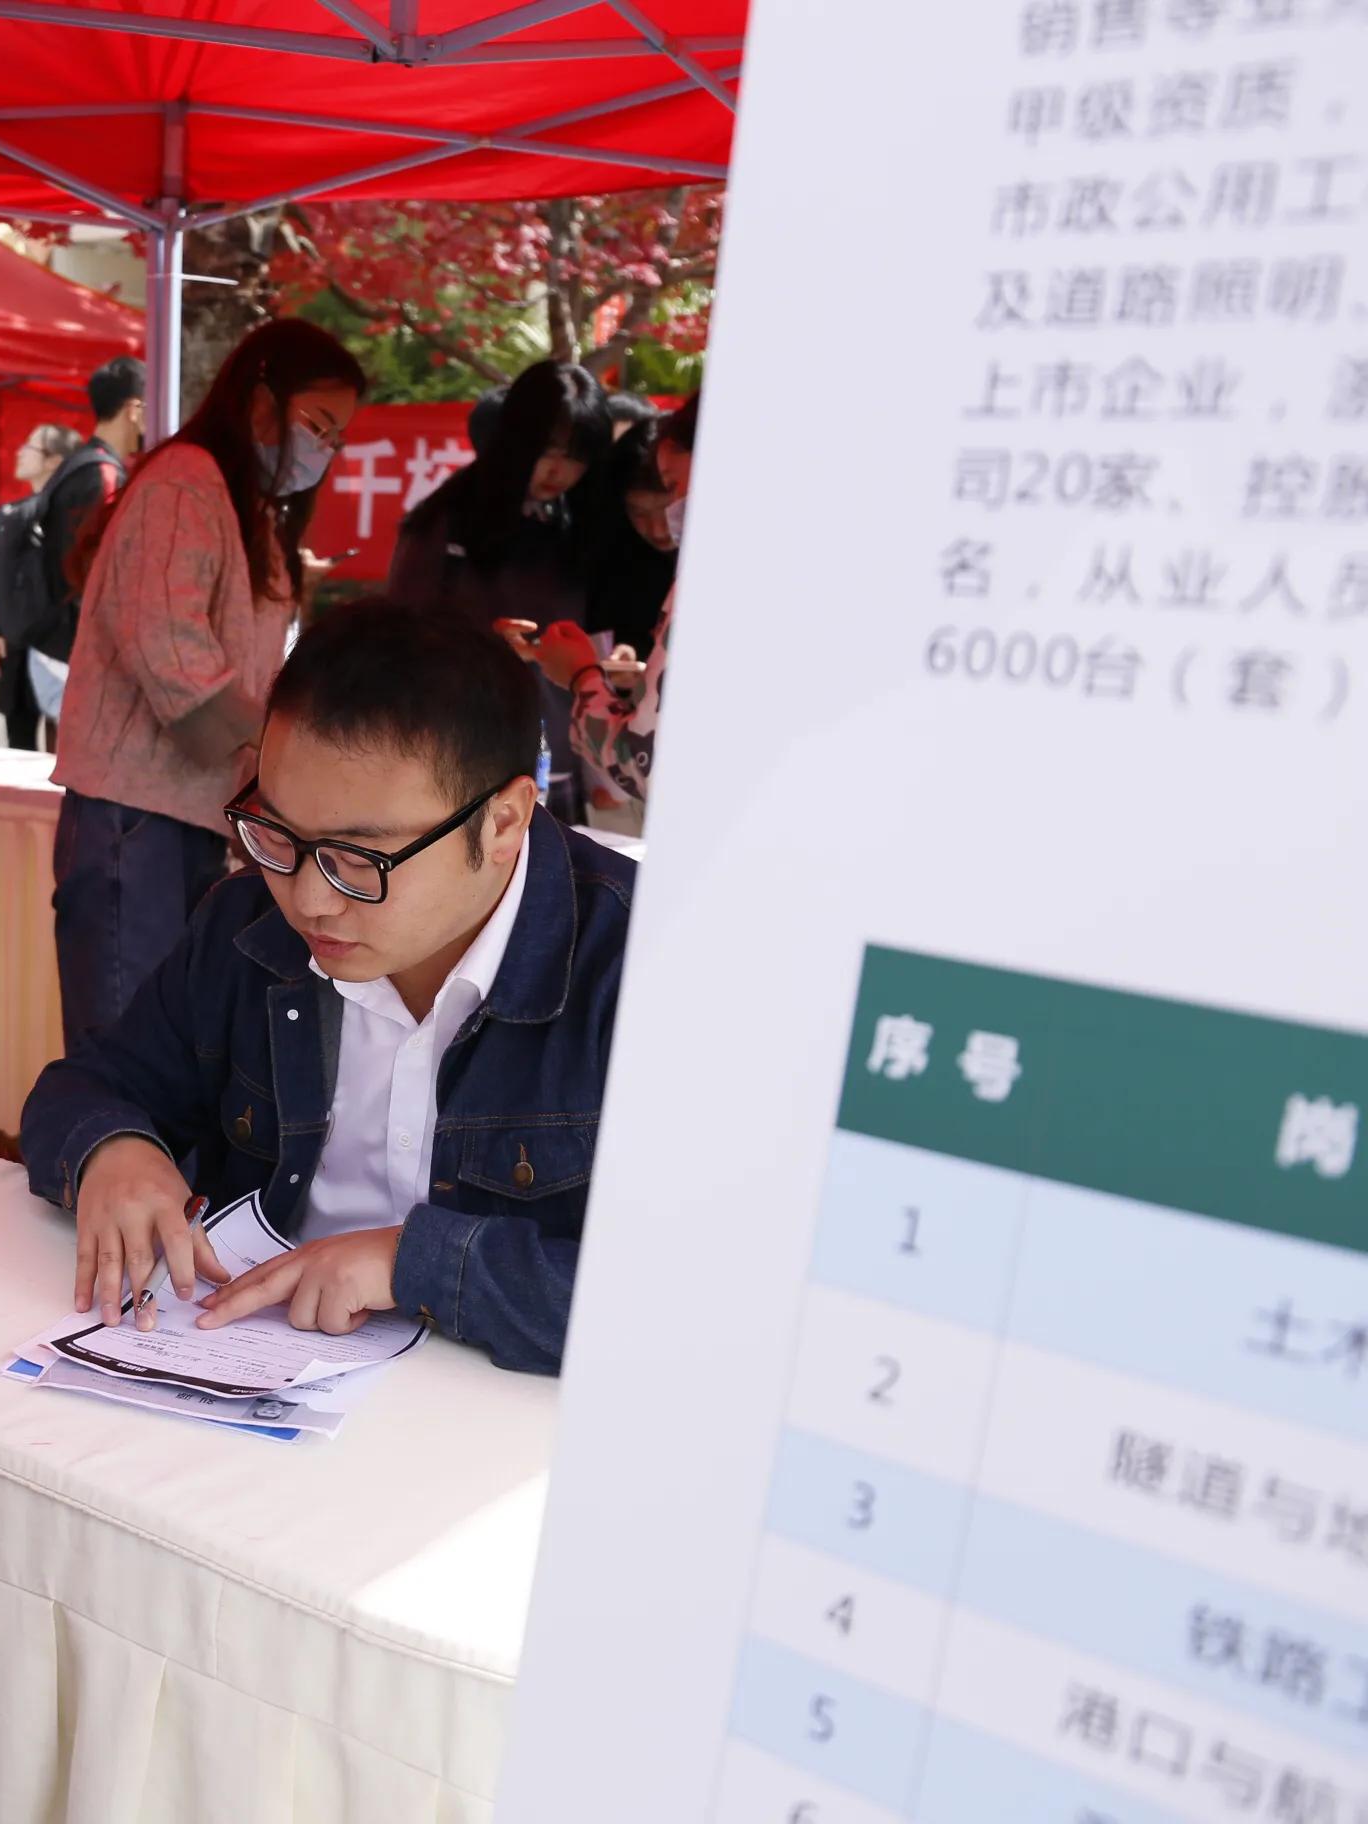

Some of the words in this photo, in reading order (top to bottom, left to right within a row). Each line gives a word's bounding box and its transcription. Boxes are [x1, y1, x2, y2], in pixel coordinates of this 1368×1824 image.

[897, 1205, 922, 1257] 1
[867, 1356, 902, 1404] 2
[846, 1480, 877, 1531] 3
[823, 1595, 855, 1636] 4
[808, 1694, 836, 1744] 5
